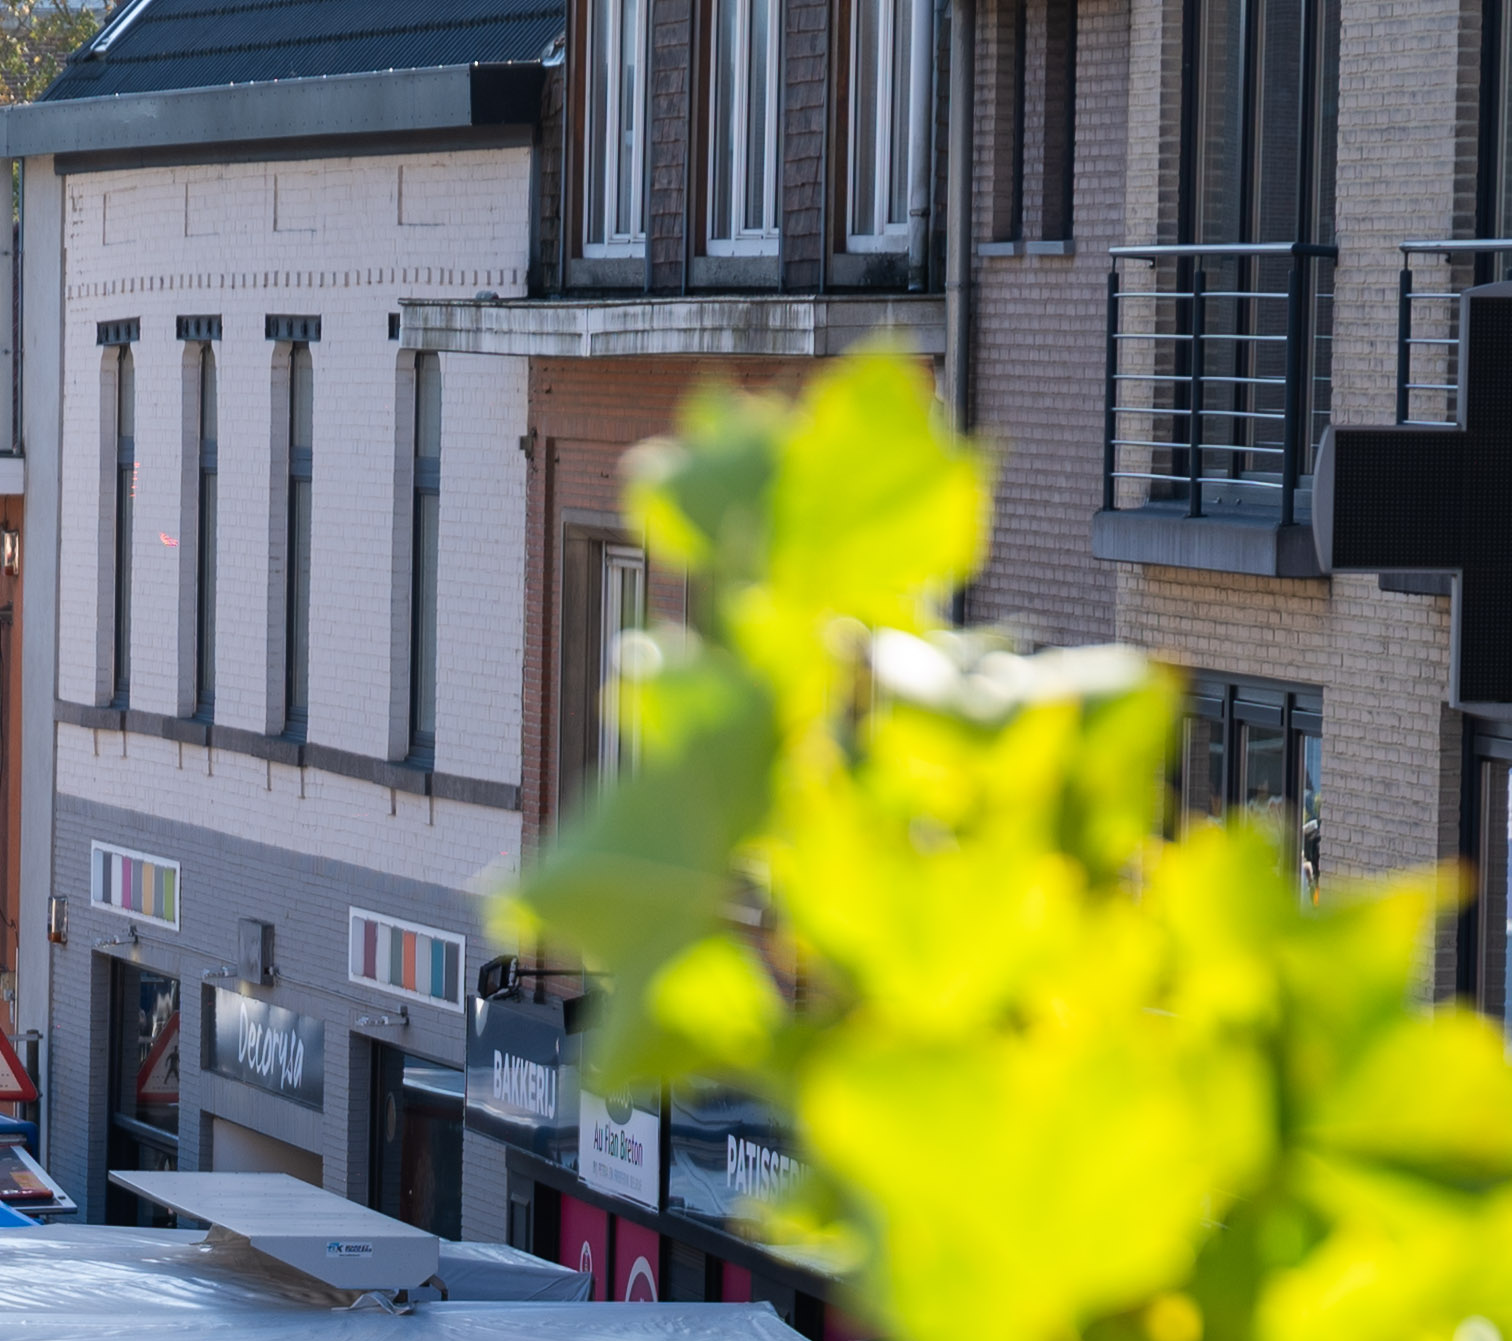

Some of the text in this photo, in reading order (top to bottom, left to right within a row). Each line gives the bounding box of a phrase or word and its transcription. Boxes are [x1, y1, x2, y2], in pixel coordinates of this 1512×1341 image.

[493, 1049, 557, 1120] BAKKERIJ
[593, 1120, 644, 1167] Au Flan Breton
